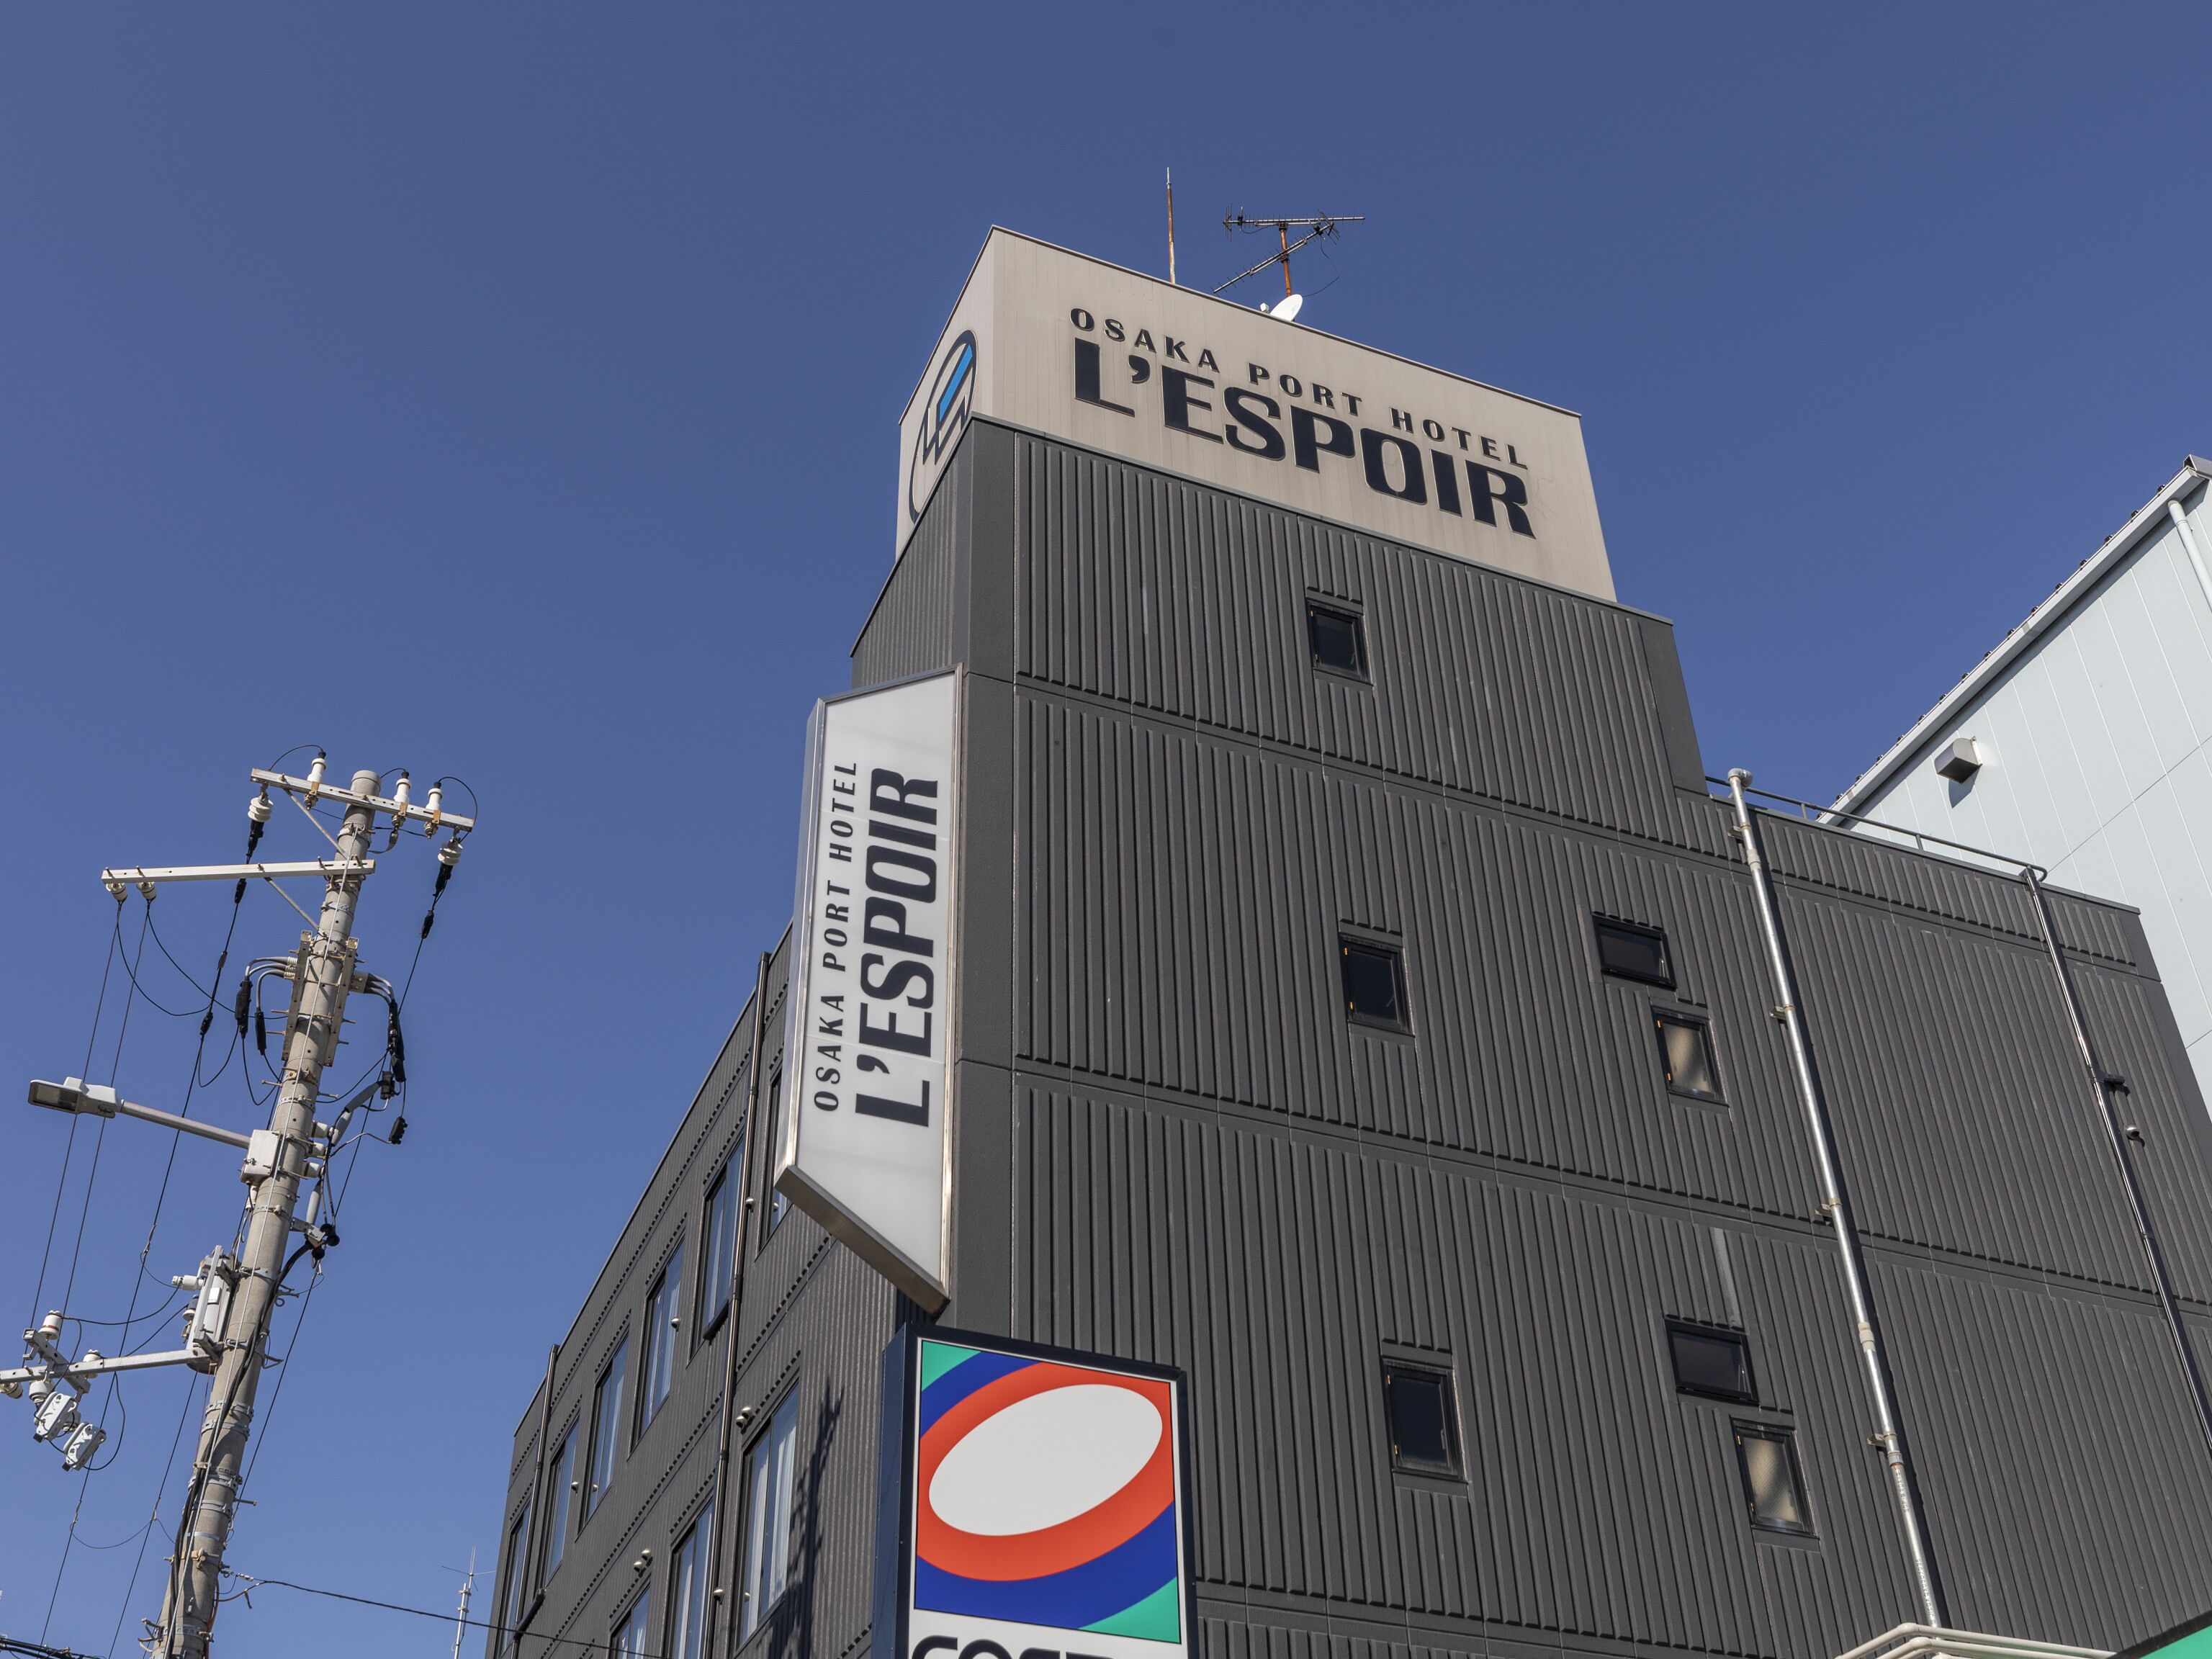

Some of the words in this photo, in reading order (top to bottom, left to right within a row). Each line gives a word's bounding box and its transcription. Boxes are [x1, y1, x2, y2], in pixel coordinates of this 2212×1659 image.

[1070, 307, 1220, 374] OSAKA
[1249, 362, 1362, 417] PORT
[1390, 408, 1528, 470] HOTEL
[1074, 337, 1537, 540] L'ESPOIR
[829, 763, 856, 863] HOTEL
[823, 880, 850, 972] PORT
[855, 768, 938, 1128] L'ESPOIR
[814, 995, 845, 1112] OSAKA
